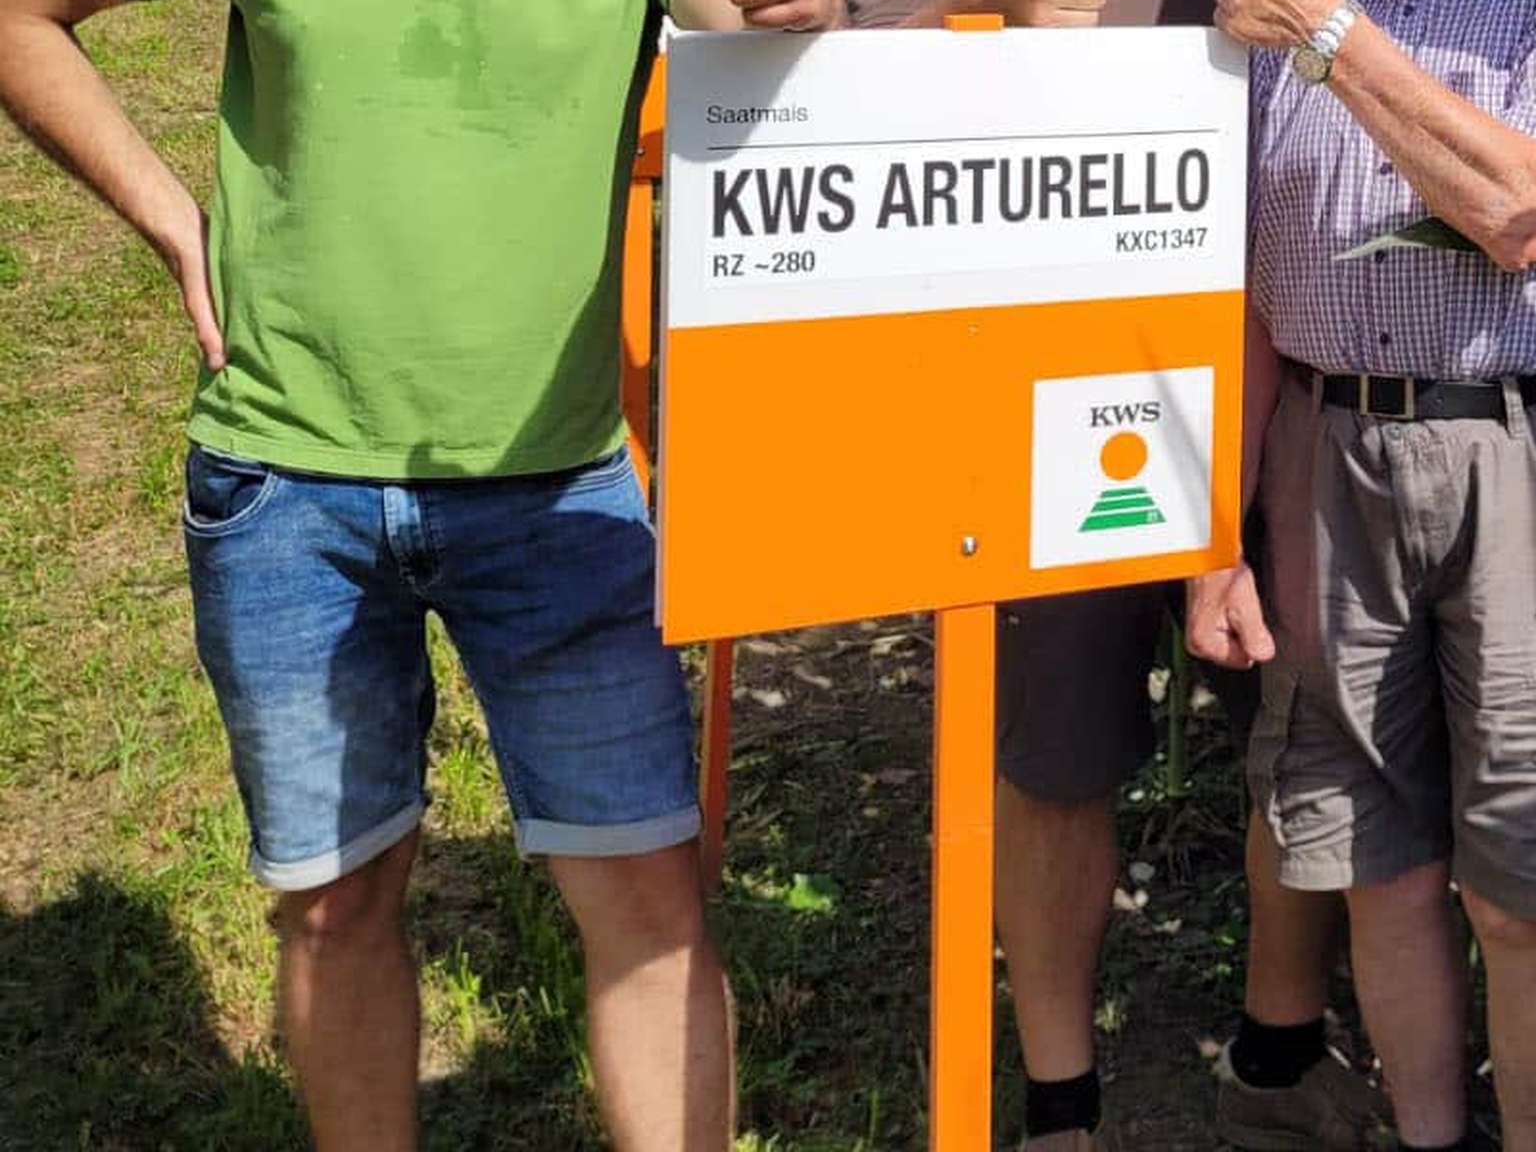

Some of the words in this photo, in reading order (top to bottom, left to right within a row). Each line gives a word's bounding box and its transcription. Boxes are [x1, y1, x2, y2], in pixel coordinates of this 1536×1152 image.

[706, 104, 808, 124] Saatmais
[712, 164, 855, 238] KWS
[876, 148, 1210, 229] ARTURELLO
[1115, 227, 1207, 253] KXC1347
[712, 253, 745, 277] RZ
[755, 250, 816, 275] ~280
[1090, 401, 1161, 427] KWS
